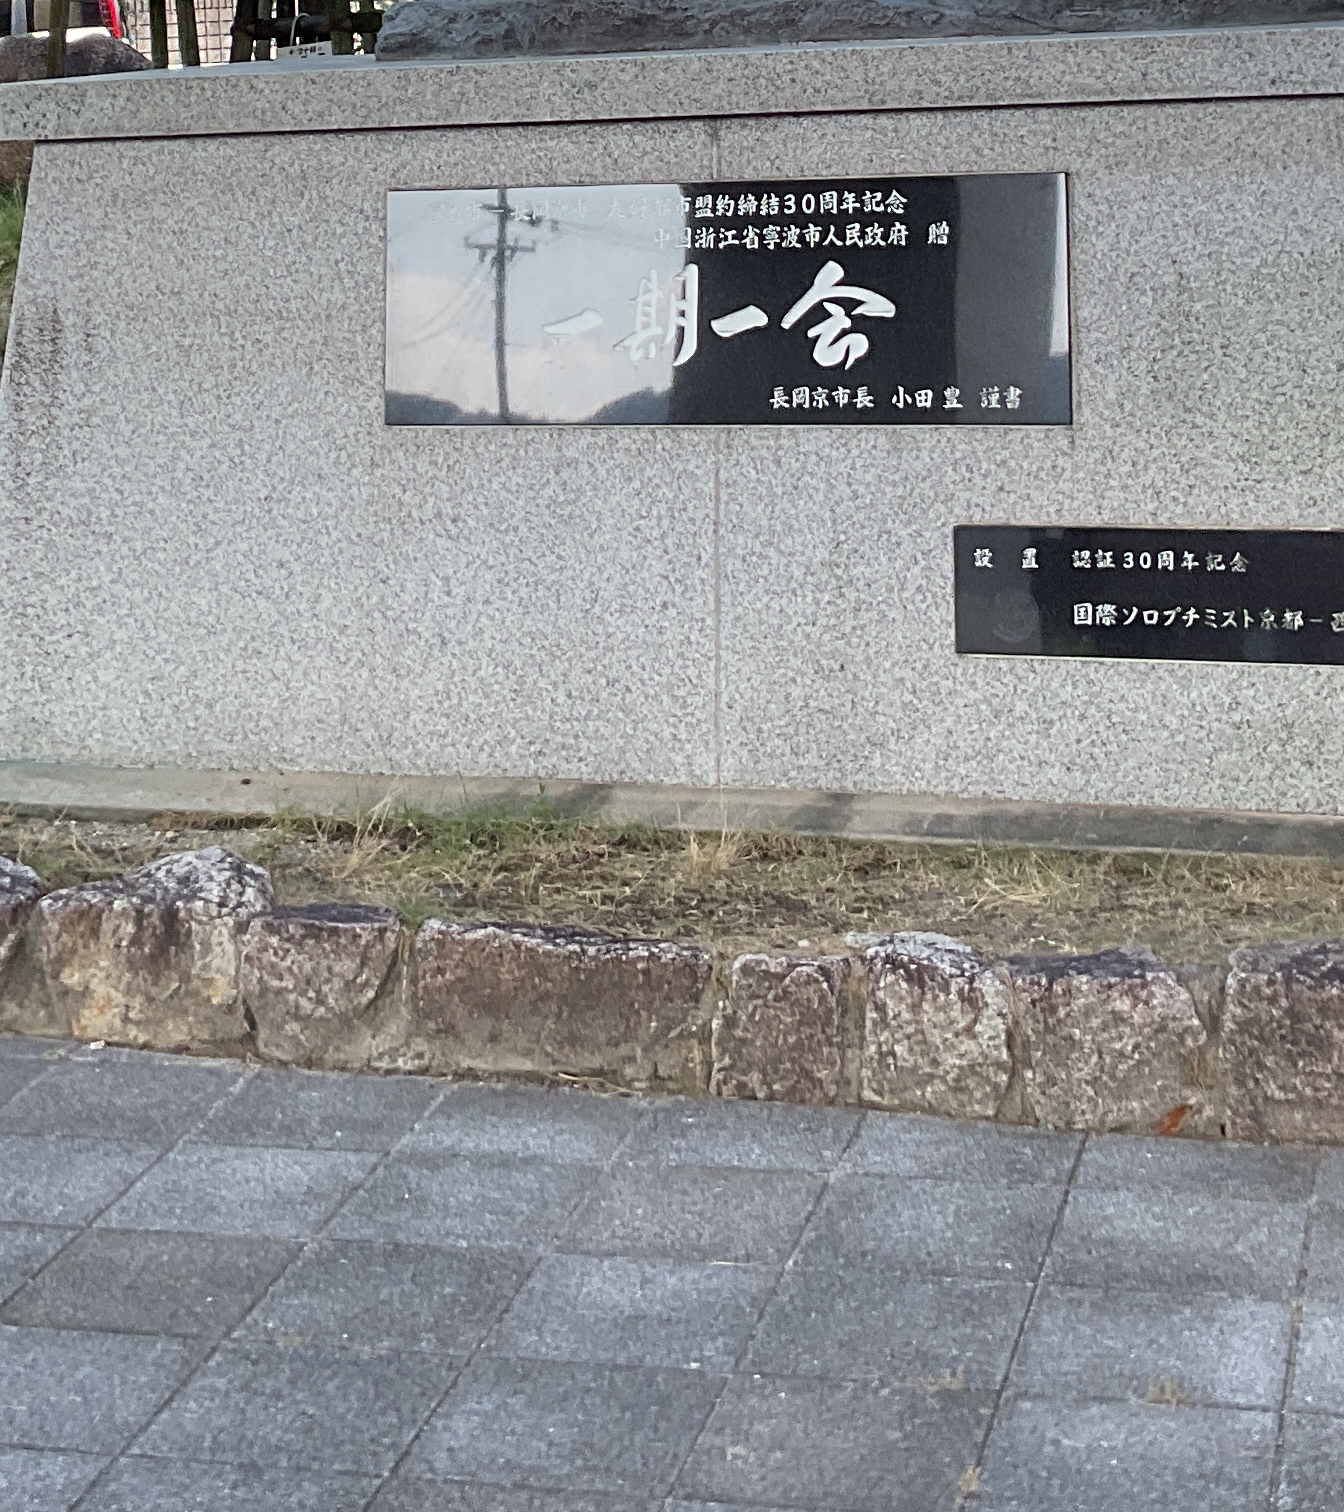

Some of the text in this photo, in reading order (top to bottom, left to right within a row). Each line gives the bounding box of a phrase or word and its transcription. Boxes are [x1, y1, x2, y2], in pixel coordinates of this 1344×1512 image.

[927, 221, 949, 245] 贈
[542, 259, 896, 371] 一期一会
[769, 386, 874, 409] 長岡京市長
[980, 386, 1022, 409] 謹書
[1072, 550, 1249, 572] 認証30周年記念
